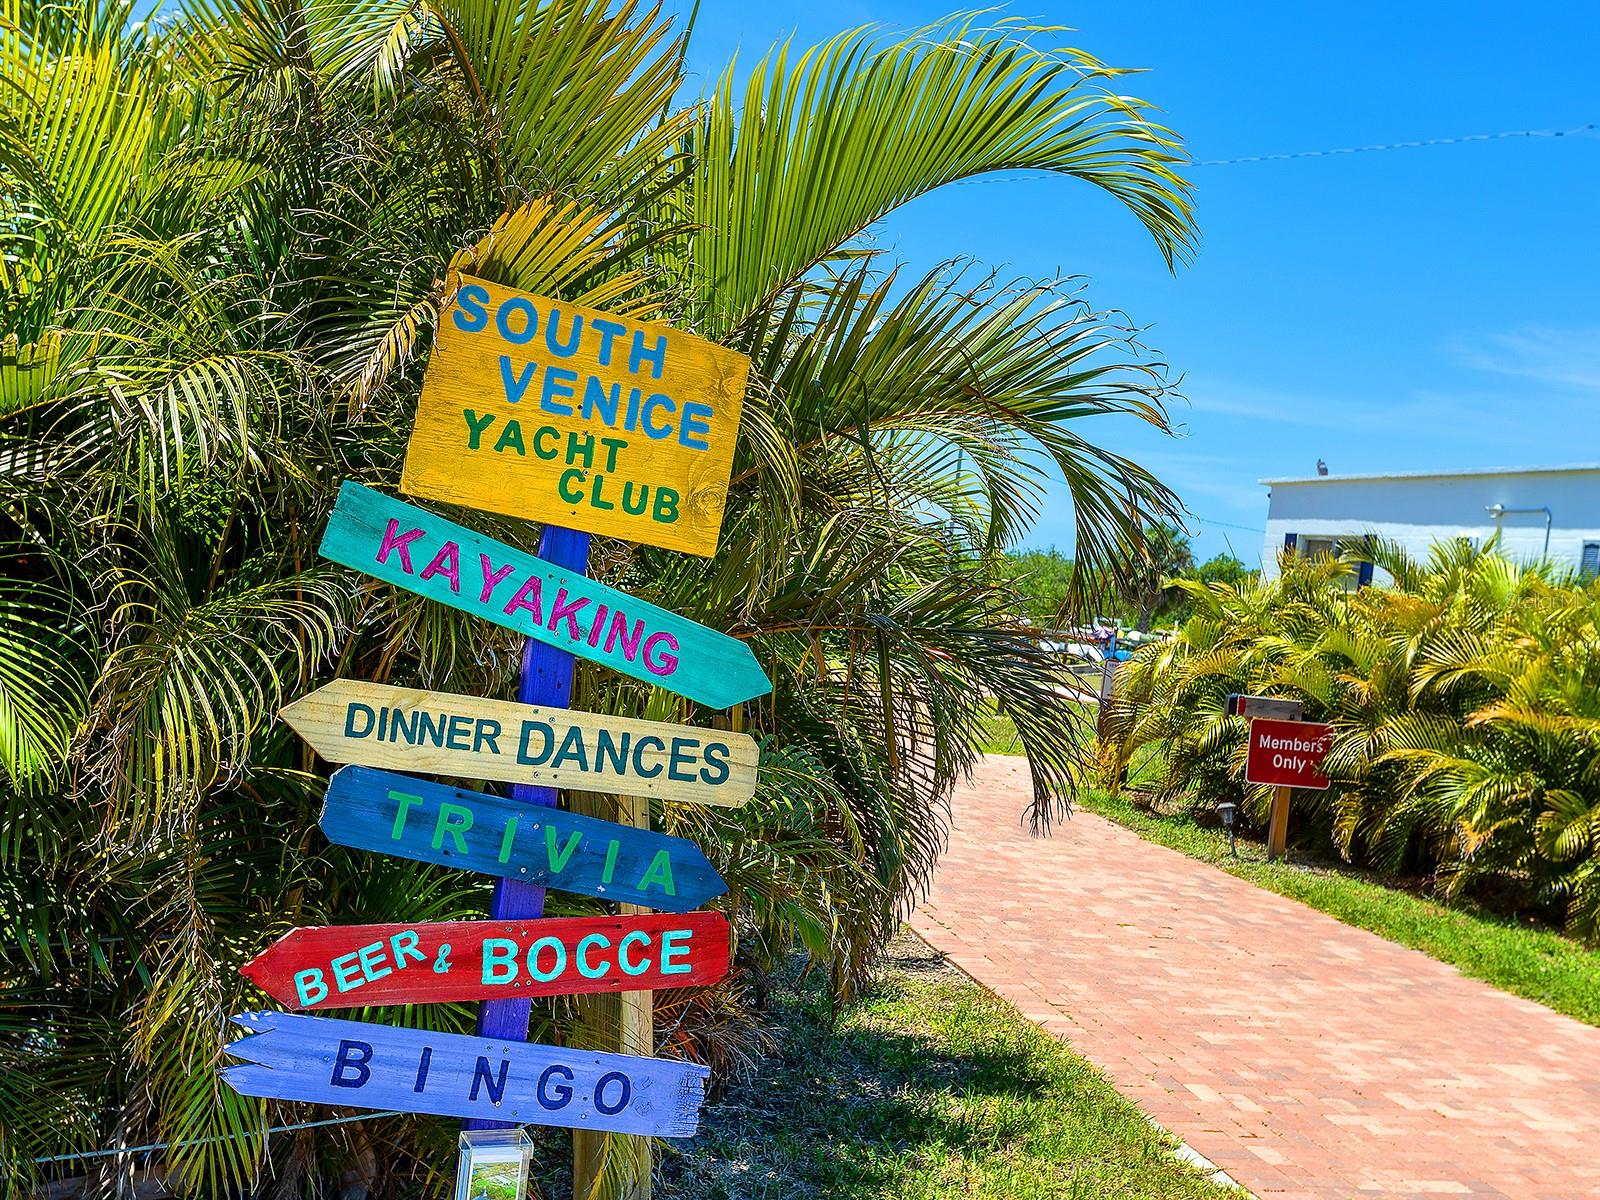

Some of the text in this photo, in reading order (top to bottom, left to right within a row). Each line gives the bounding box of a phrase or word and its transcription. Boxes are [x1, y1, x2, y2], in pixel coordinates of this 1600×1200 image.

[452, 284, 667, 379] SOUTH
[463, 408, 628, 473] YACHT
[499, 355, 714, 450] VENICE
[558, 468, 680, 524] CLUB
[375, 518, 680, 676] KAYAKING
[344, 702, 731, 785] DINNER DANCES
[1259, 734, 1324, 753] Members
[1273, 754, 1307, 773] Only
[387, 790, 676, 896] TRIVIA
[294, 929, 694, 1007] BEER & BOCCE
[330, 1039, 632, 1116] BINGO
